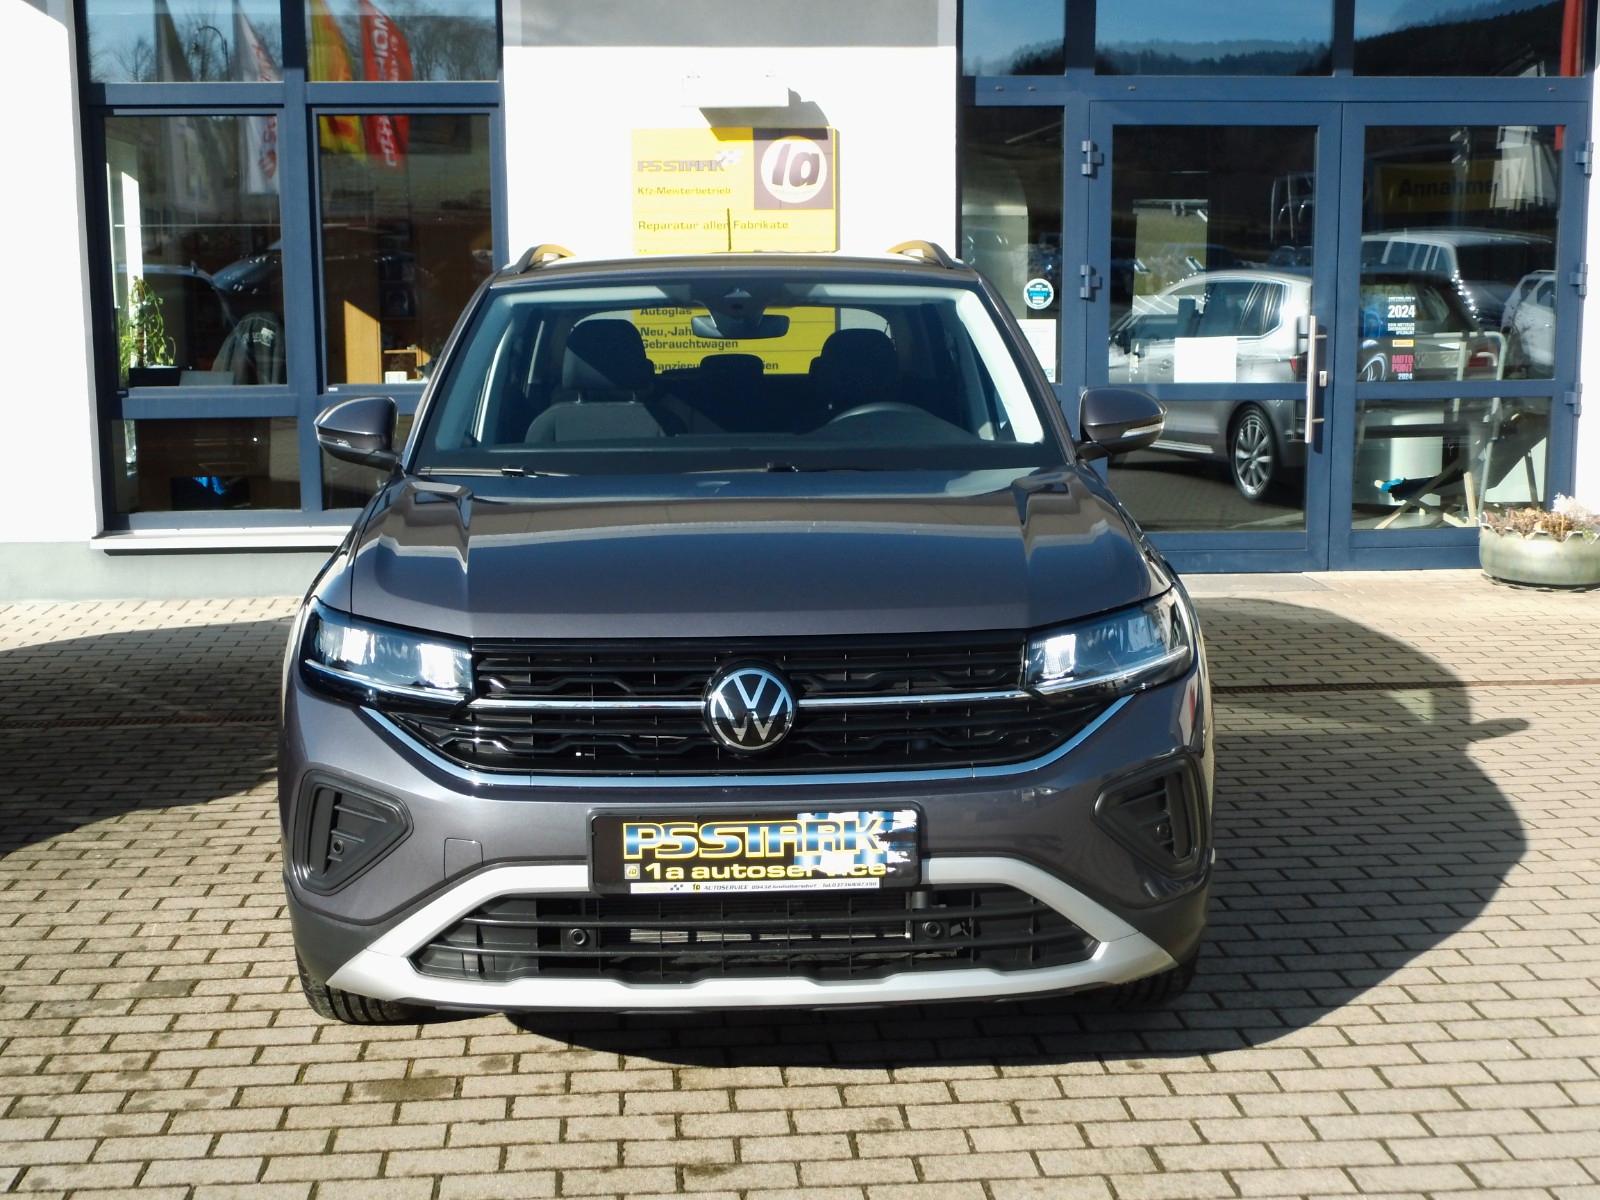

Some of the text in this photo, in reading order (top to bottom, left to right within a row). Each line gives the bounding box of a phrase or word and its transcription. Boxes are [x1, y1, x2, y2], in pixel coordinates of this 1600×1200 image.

[638, 220, 698, 231] Reparatur
[733, 220, 788, 230] Fabrikate
[1387, 304, 1416, 318] 2024
[623, 820, 884, 859] PSSTARK
[645, 862, 684, 880] 1a
